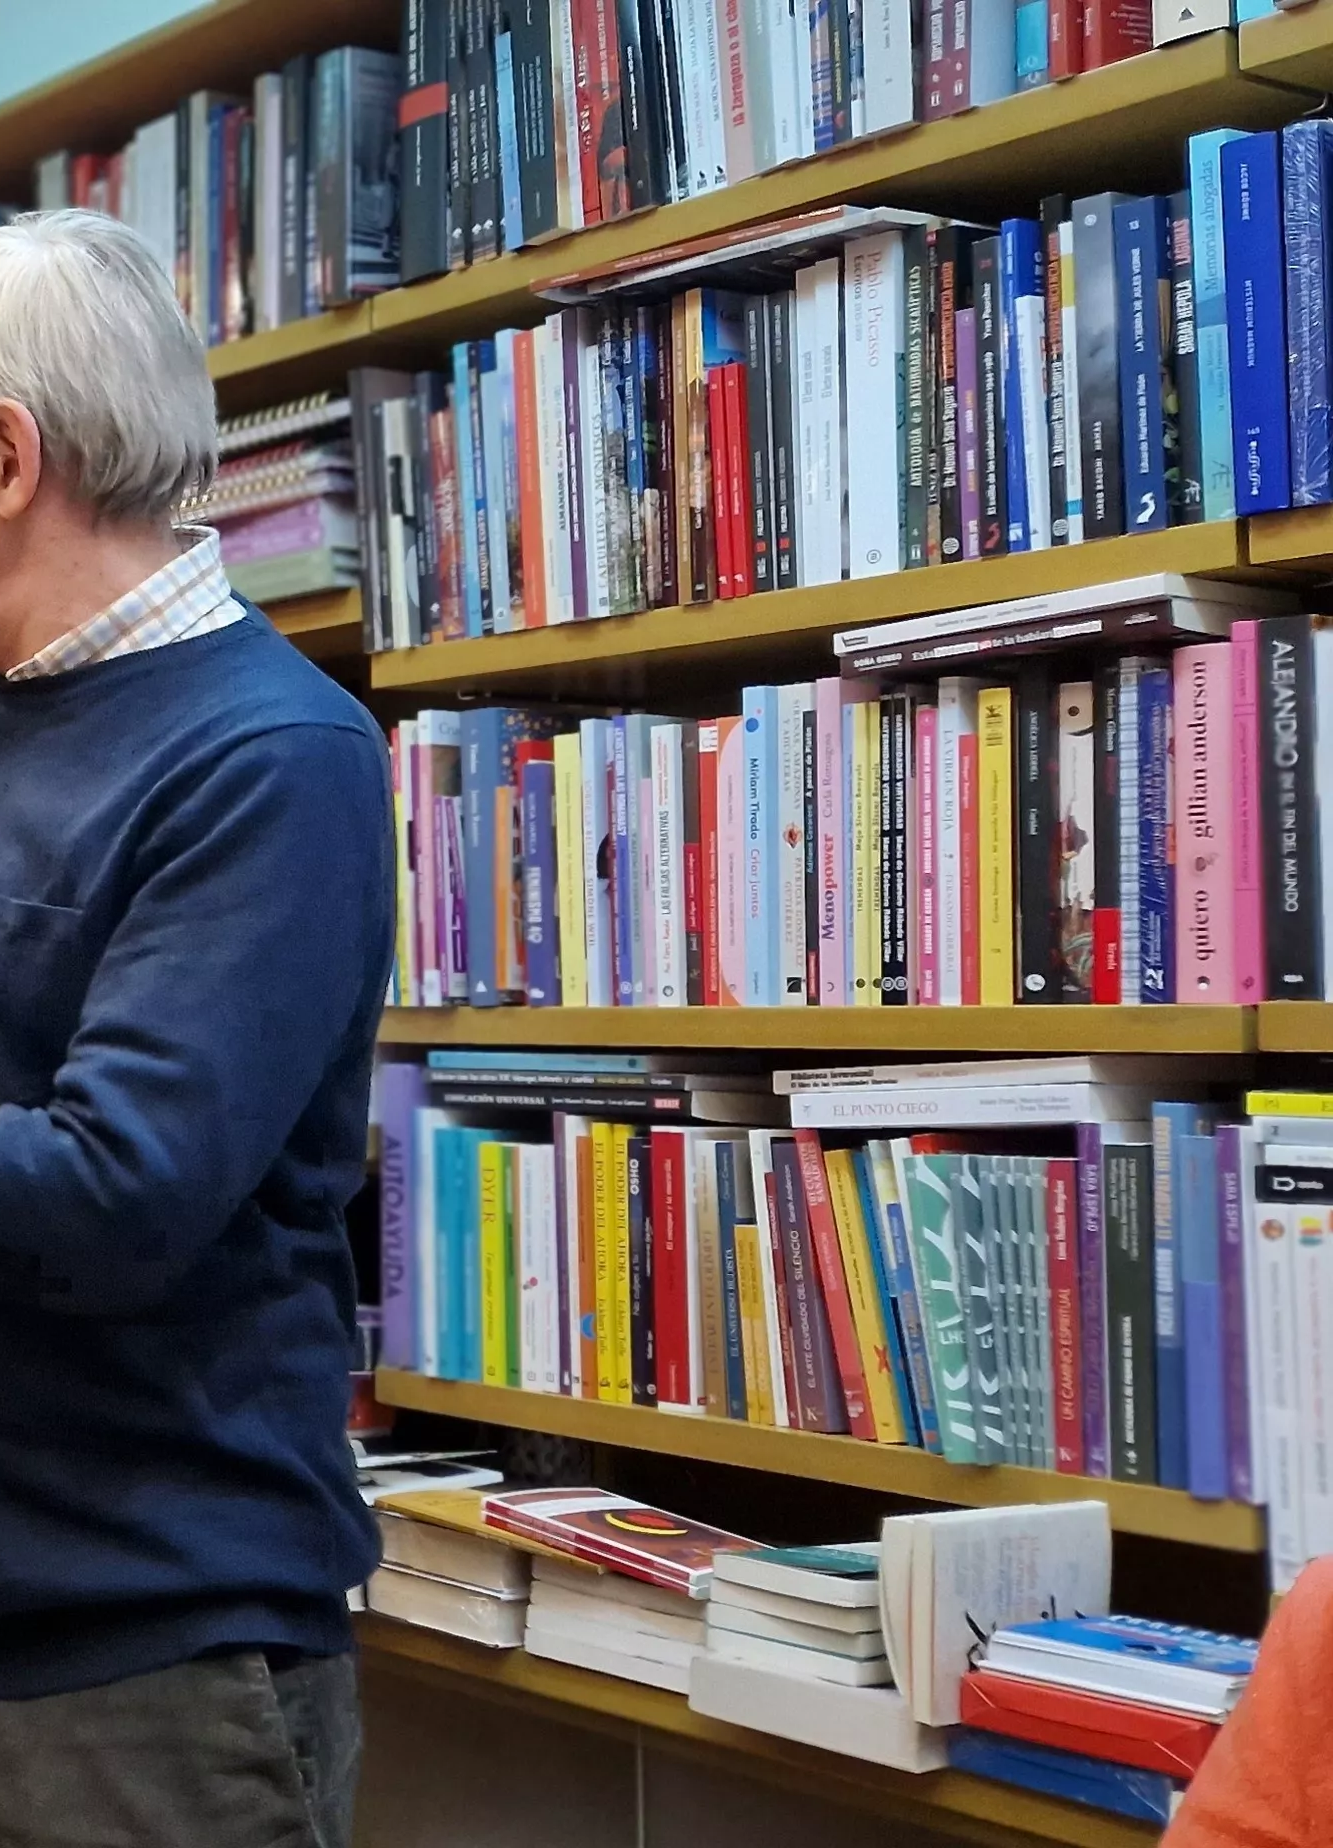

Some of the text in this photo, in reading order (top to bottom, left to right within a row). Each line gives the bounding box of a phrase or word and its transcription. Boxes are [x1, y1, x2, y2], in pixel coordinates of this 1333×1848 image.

[729, 53, 745, 110] Zaragoza
[1239, 163, 1249, 190] JACOB
[1196, 160, 1218, 290] Memorias ahogadas
[853, 255, 864, 300] Escritos
[1131, 247, 1144, 352] LA TIERRA DE JULES VERNE
[1172, 218, 1195, 355] SARAH HEPOLA LAGUNAS
[867, 251, 886, 367] Pablo Picasso
[1243, 280, 1254, 329] MYSTERIUM
[982, 319, 993, 339] Yves
[1245, 330, 1255, 368] MAGNUM
[908, 338, 922, 408] BATURRADAS
[910, 411, 922, 423] de
[1051, 397, 1064, 419] Sans
[1136, 373, 1150, 473] Eduardo Martínez de Pisón
[908, 427, 922, 487] ANTOLOGÍA
[942, 385, 957, 488] Dr. Manuel Sans Segarra
[1051, 420, 1064, 453] Manuel
[985, 460, 995, 472] los
[1052, 453, 1065, 467] Dr.
[792, 699, 802, 810] SIRENAS, AMAZONAS
[882, 715, 890, 781] MATERNIDADES
[895, 714, 904, 780] MATERNIDADES
[943, 729, 954, 748] LA
[1105, 720, 1117, 752] Gibson
[943, 748, 954, 797] VIRGEN
[1271, 640, 1299, 912] ALEJANDRO FIN DEL MUNDO
[803, 727, 815, 875] Adriana Cavarero A pesar de Platón
[855, 801, 863, 827] Siscar
[882, 781, 890, 831] VIRTUOSAS
[895, 780, 904, 830] VIRTUOSAS
[941, 799, 955, 831] ROJA
[1187, 660, 1217, 961] quiero gillian anderson
[820, 732, 838, 941] Menopower Carla Romagosa
[658, 810, 671, 915] LAS FALSAS ALTERNATIVAS
[748, 801, 761, 919] Tirado Criar juntos
[586, 878, 595, 918] SIMONE
[784, 880, 794, 944] GUTIÉRREZ
[873, 865, 881, 913] TREMENDAS
[882, 872, 891, 907] Cebreiro
[895, 871, 905, 907] Cebreiro
[944, 873, 954, 927] FERNANDO
[794, 857, 804, 968] PATRICIA GONZÁLEZ
[882, 940, 891, 963] Villar
[895, 940, 905, 962] Villar
[495, 1094, 547, 1106] UNIVERSAL
[832, 1102, 939, 1117] EL PUNTO CIEGO
[594, 1141, 604, 1155] EL
[615, 1142, 625, 1156] EL
[481, 1166, 497, 1225] DYER
[594, 1159, 605, 1204] PODER
[615, 1160, 626, 1205] PODER
[629, 1158, 640, 1195] OSHO
[1085, 1163, 1098, 1191] SARA
[1223, 1172, 1238, 1200] SARA
[383, 1136, 406, 1300] AUTOAYUDA
[595, 1206, 606, 1233] DEL
[616, 1207, 627, 1234] DEL
[596, 1233, 607, 1283] AHORA
[616, 1235, 628, 1284] AHORA
[782, 1164, 817, 1388] EL ARTE OLVIDADO DEL SILENCIO Sarah Anderson
[595, 1296, 608, 1332] Eckhart
[616, 1298, 629, 1335] Eckhart
[632, 1302, 641, 1316] No
[1058, 1288, 1074, 1421] UN CAMINO ESPIRITUAL
